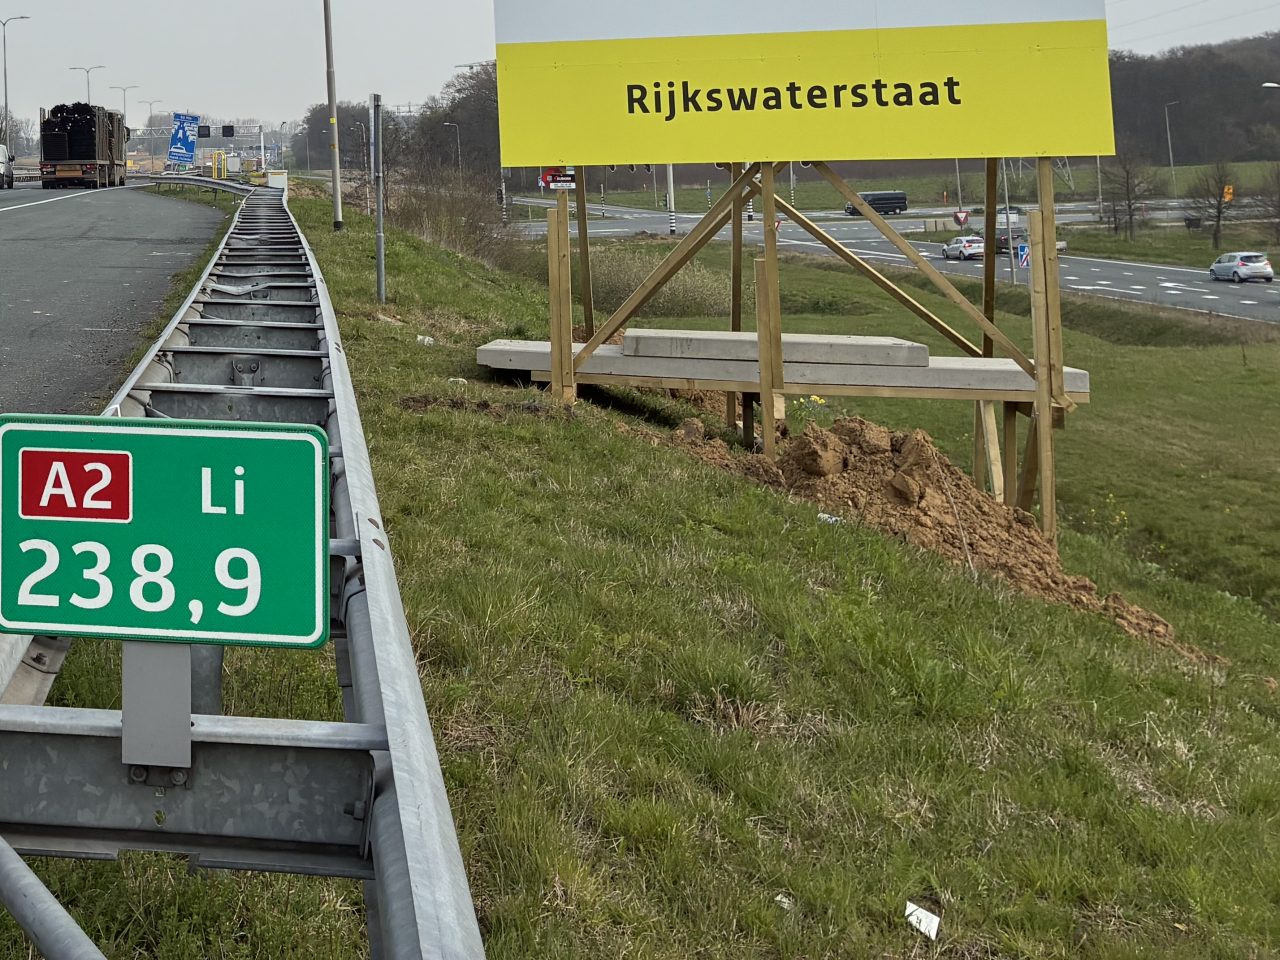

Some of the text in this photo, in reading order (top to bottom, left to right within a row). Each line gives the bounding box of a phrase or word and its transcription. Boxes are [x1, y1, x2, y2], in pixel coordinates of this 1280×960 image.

[626, 76, 962, 122] Rijkswaterstaat
[39, 461, 245, 515] A2 Li
[17, 538, 262, 625] 238,9
